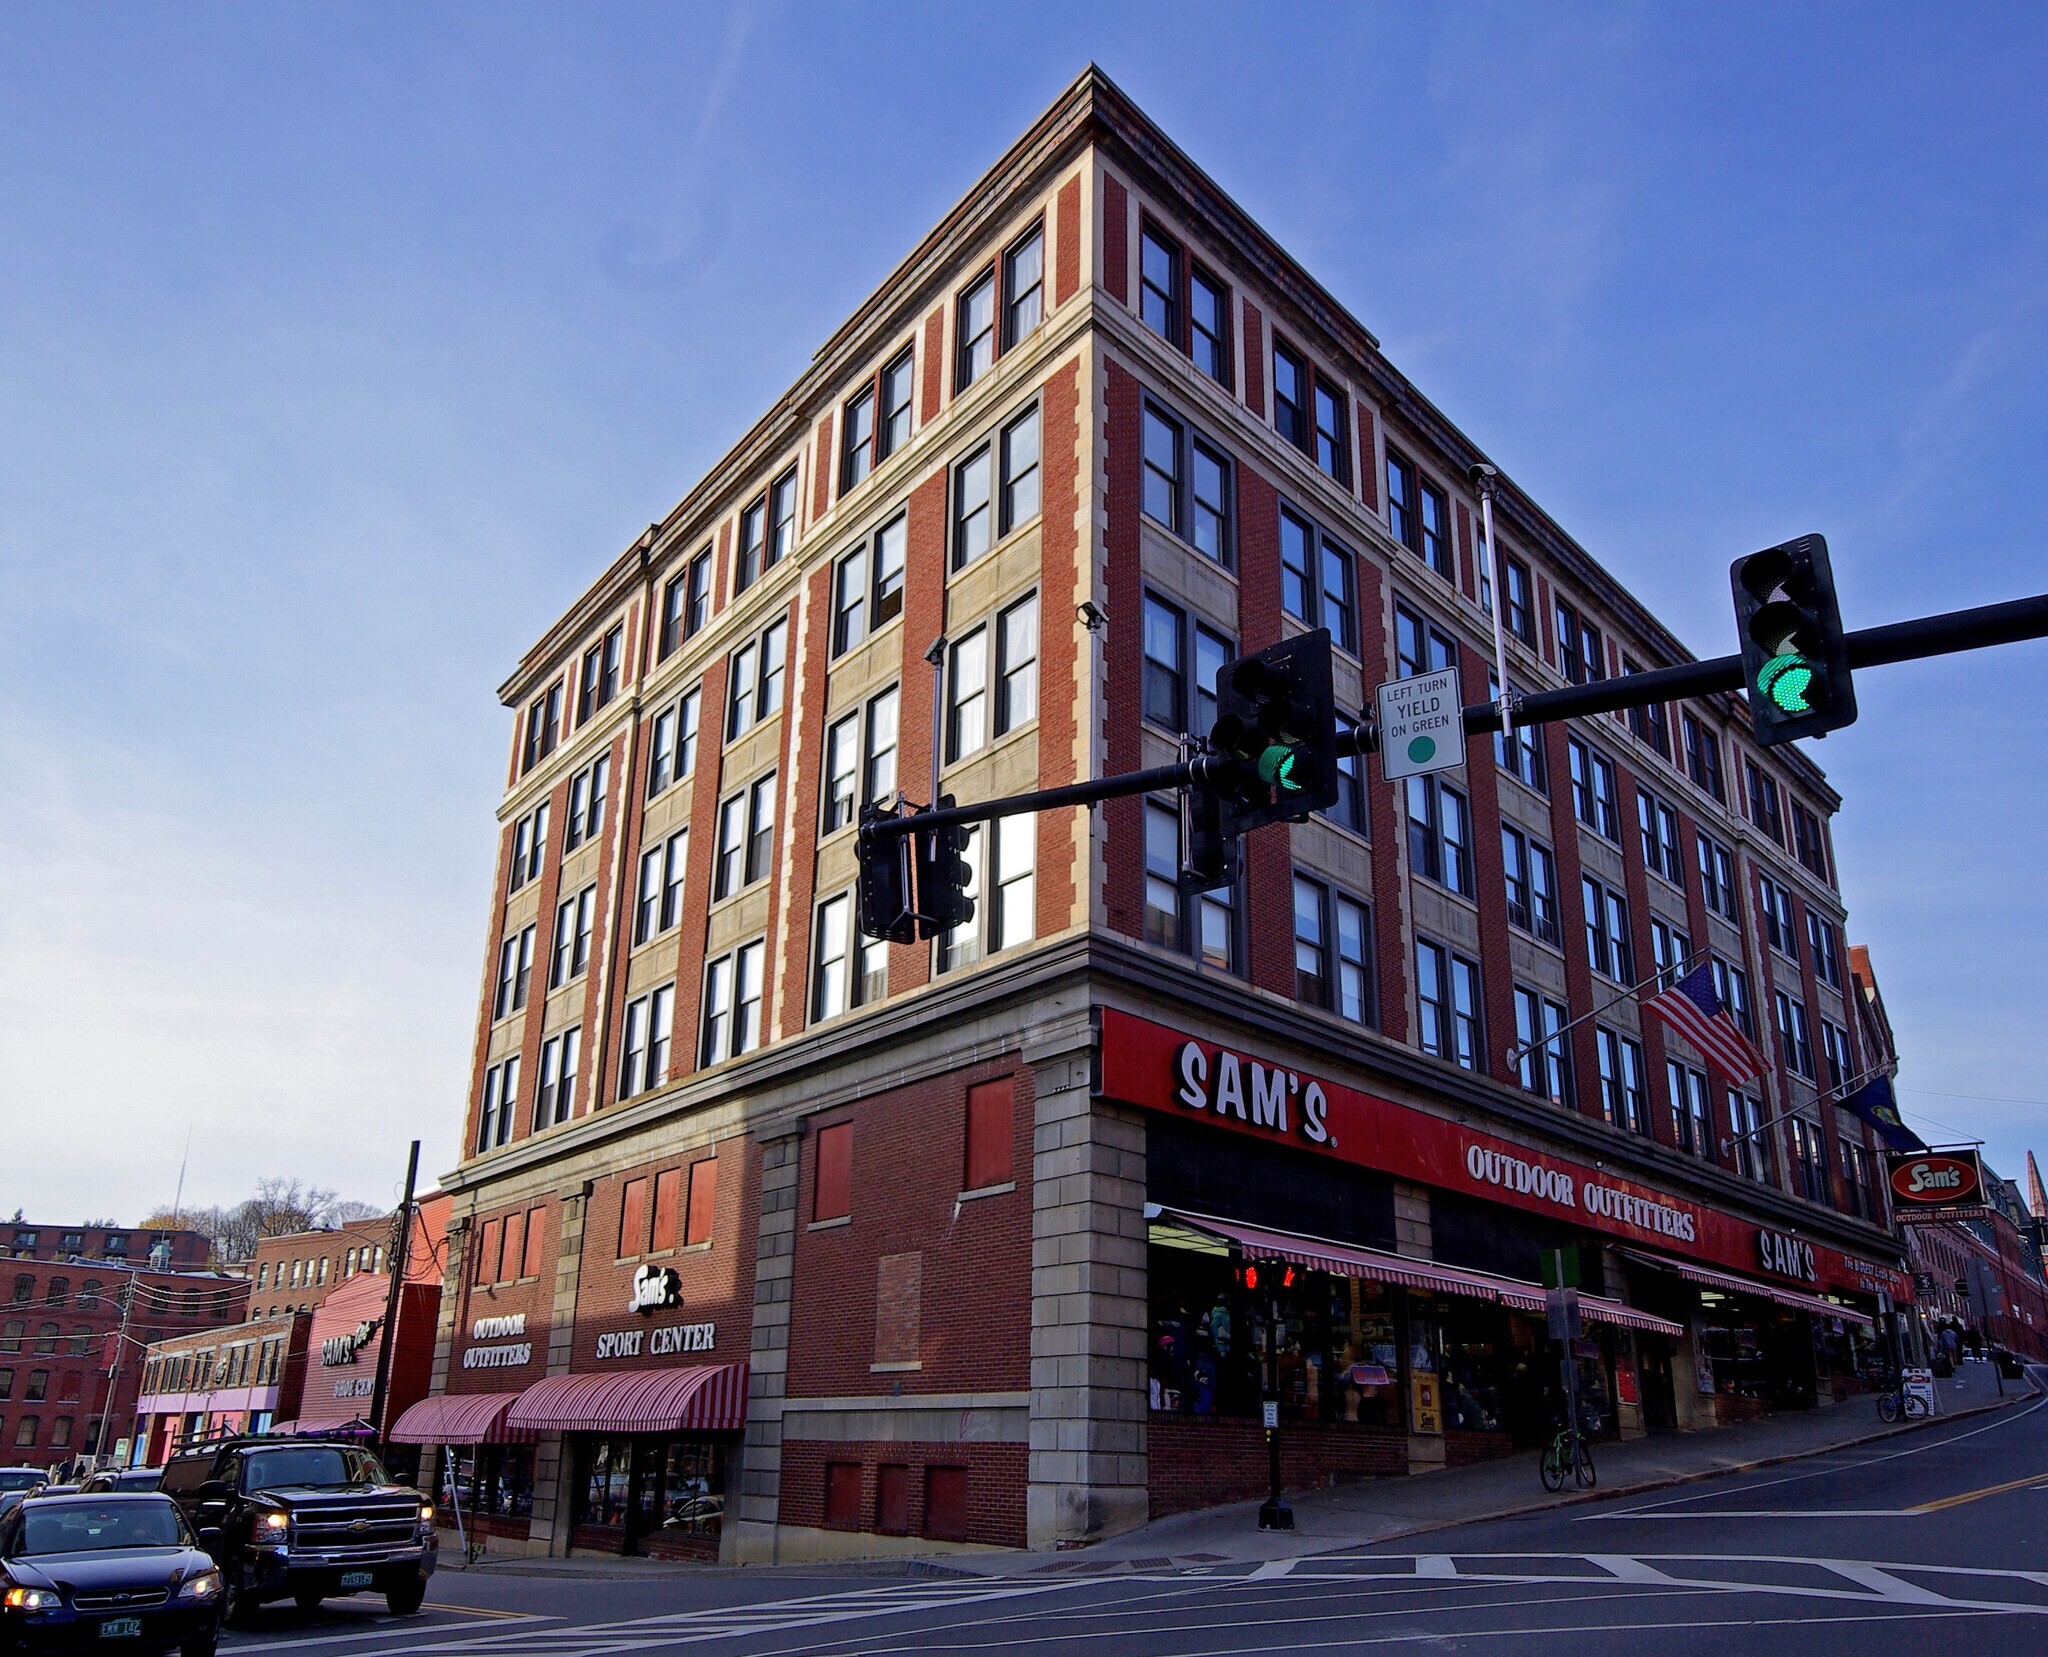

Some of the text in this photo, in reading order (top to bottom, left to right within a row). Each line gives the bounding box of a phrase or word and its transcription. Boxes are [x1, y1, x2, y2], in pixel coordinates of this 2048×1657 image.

[1387, 678, 1447, 702] LEFT TURN
[1397, 697, 1440, 719] YIELD
[1391, 715, 1449, 737] ON GREEN
[1908, 1164, 1960, 1192] Sam's
[1466, 1144, 1695, 1242] OUTDOOR OUTFITTERS
[1896, 1209, 1984, 1222] OUTDOOR OUTFITTERS
[1844, 1256, 1854, 1270] The
[1854, 1259, 1874, 1275] BIGGEST
[473, 1313, 526, 1340] OUTDOOR
[596, 1323, 715, 1359] SPORT CENTER
[463, 1342, 532, 1369] OUTFITTERS
[333, 1380, 354, 1398] SHOE
